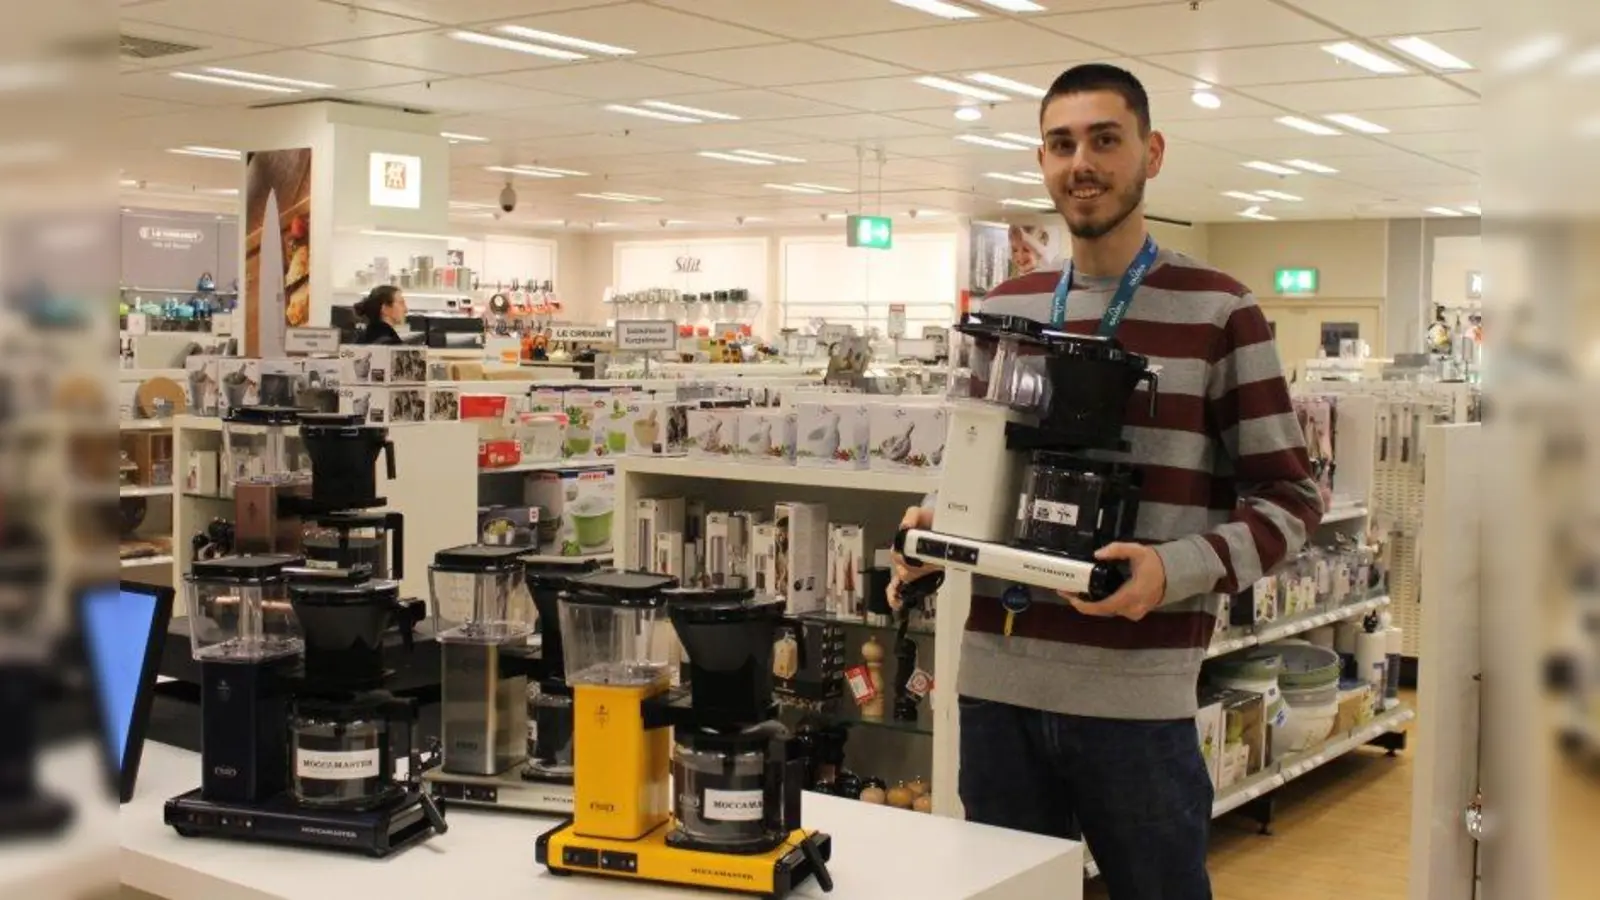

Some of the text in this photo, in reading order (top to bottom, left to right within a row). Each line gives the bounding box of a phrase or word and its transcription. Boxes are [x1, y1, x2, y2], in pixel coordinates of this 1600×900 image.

[303, 758, 373, 770] MOCCAMASTER
[301, 826, 358, 839] MOCCAMASTER
[691, 867, 754, 880] MOCCAMASTER
